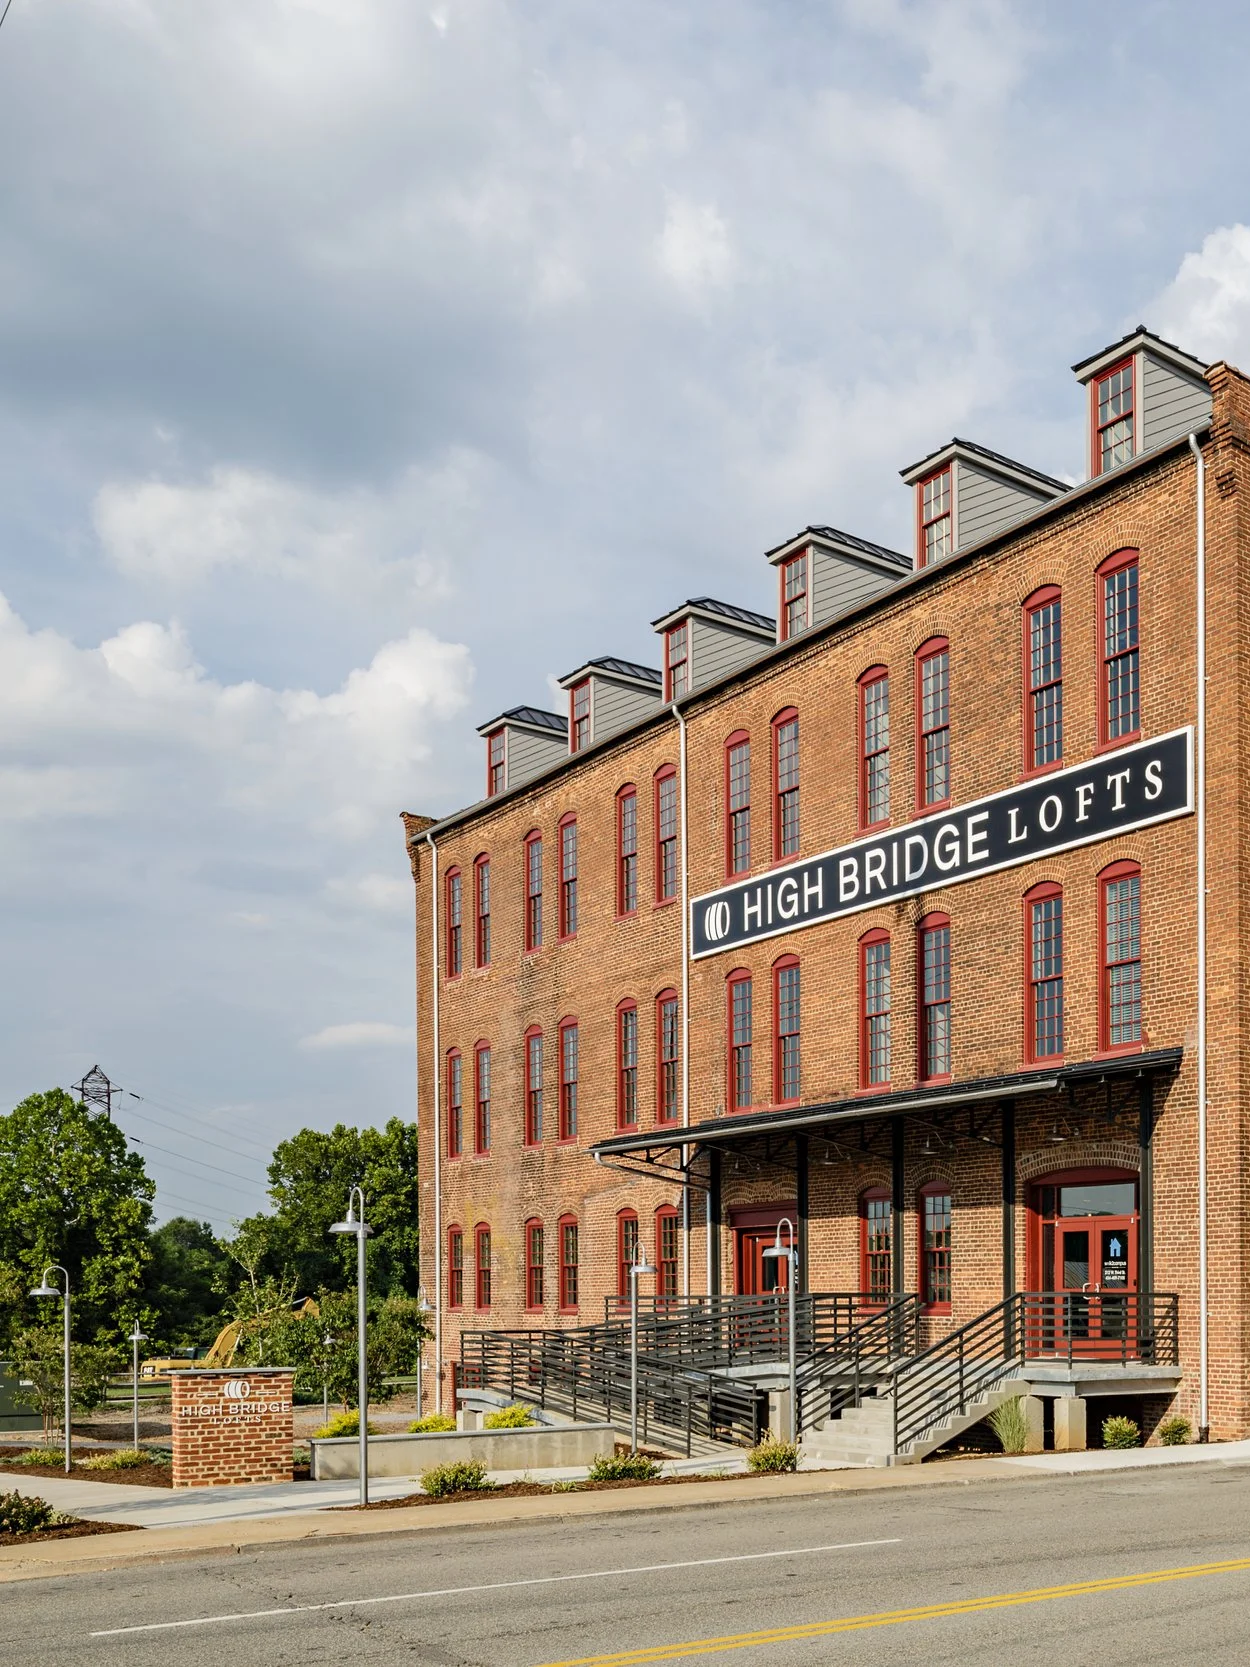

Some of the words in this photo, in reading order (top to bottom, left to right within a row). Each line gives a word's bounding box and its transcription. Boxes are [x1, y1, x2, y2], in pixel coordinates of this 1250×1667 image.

[743, 866, 823, 932] HIGH
[839, 811, 990, 902] BRIDGE
[1007, 760, 1163, 844] LOFTS
[182, 1404, 223, 1416] HIGH
[229, 1401, 291, 1415] BRIDGE
[213, 1416, 262, 1425] LOFTS
